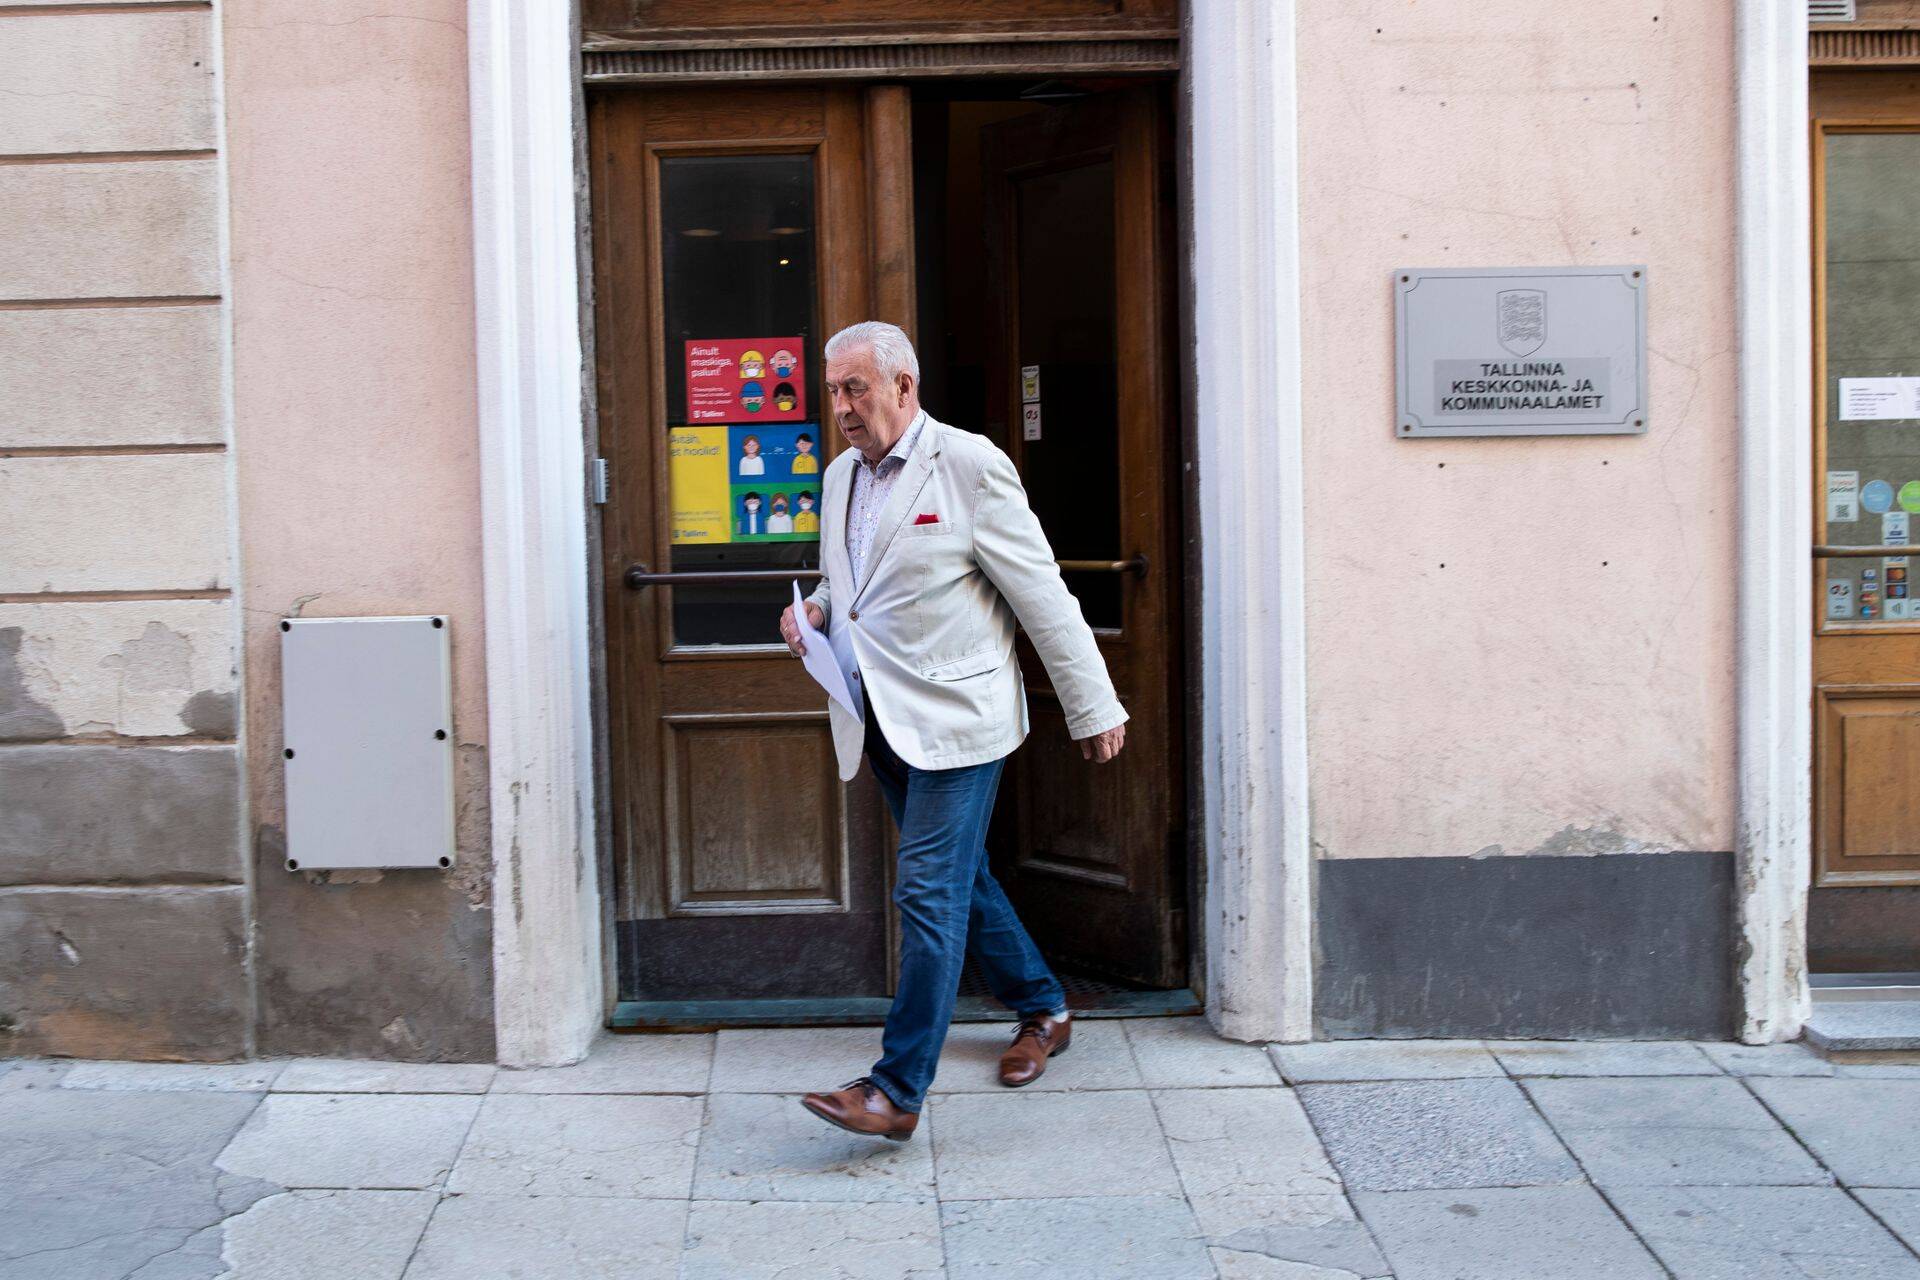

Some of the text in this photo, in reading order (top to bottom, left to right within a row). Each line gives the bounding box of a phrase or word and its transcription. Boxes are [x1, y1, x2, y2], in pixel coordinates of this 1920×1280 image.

[691, 346, 720, 356] Ainult
[691, 367, 721, 378] palun!
[1480, 362, 1565, 377] TALLINNA
[1452, 379, 1595, 394] KESKKONNA- JA
[1441, 395, 1605, 411] KOMMUNAALAMET
